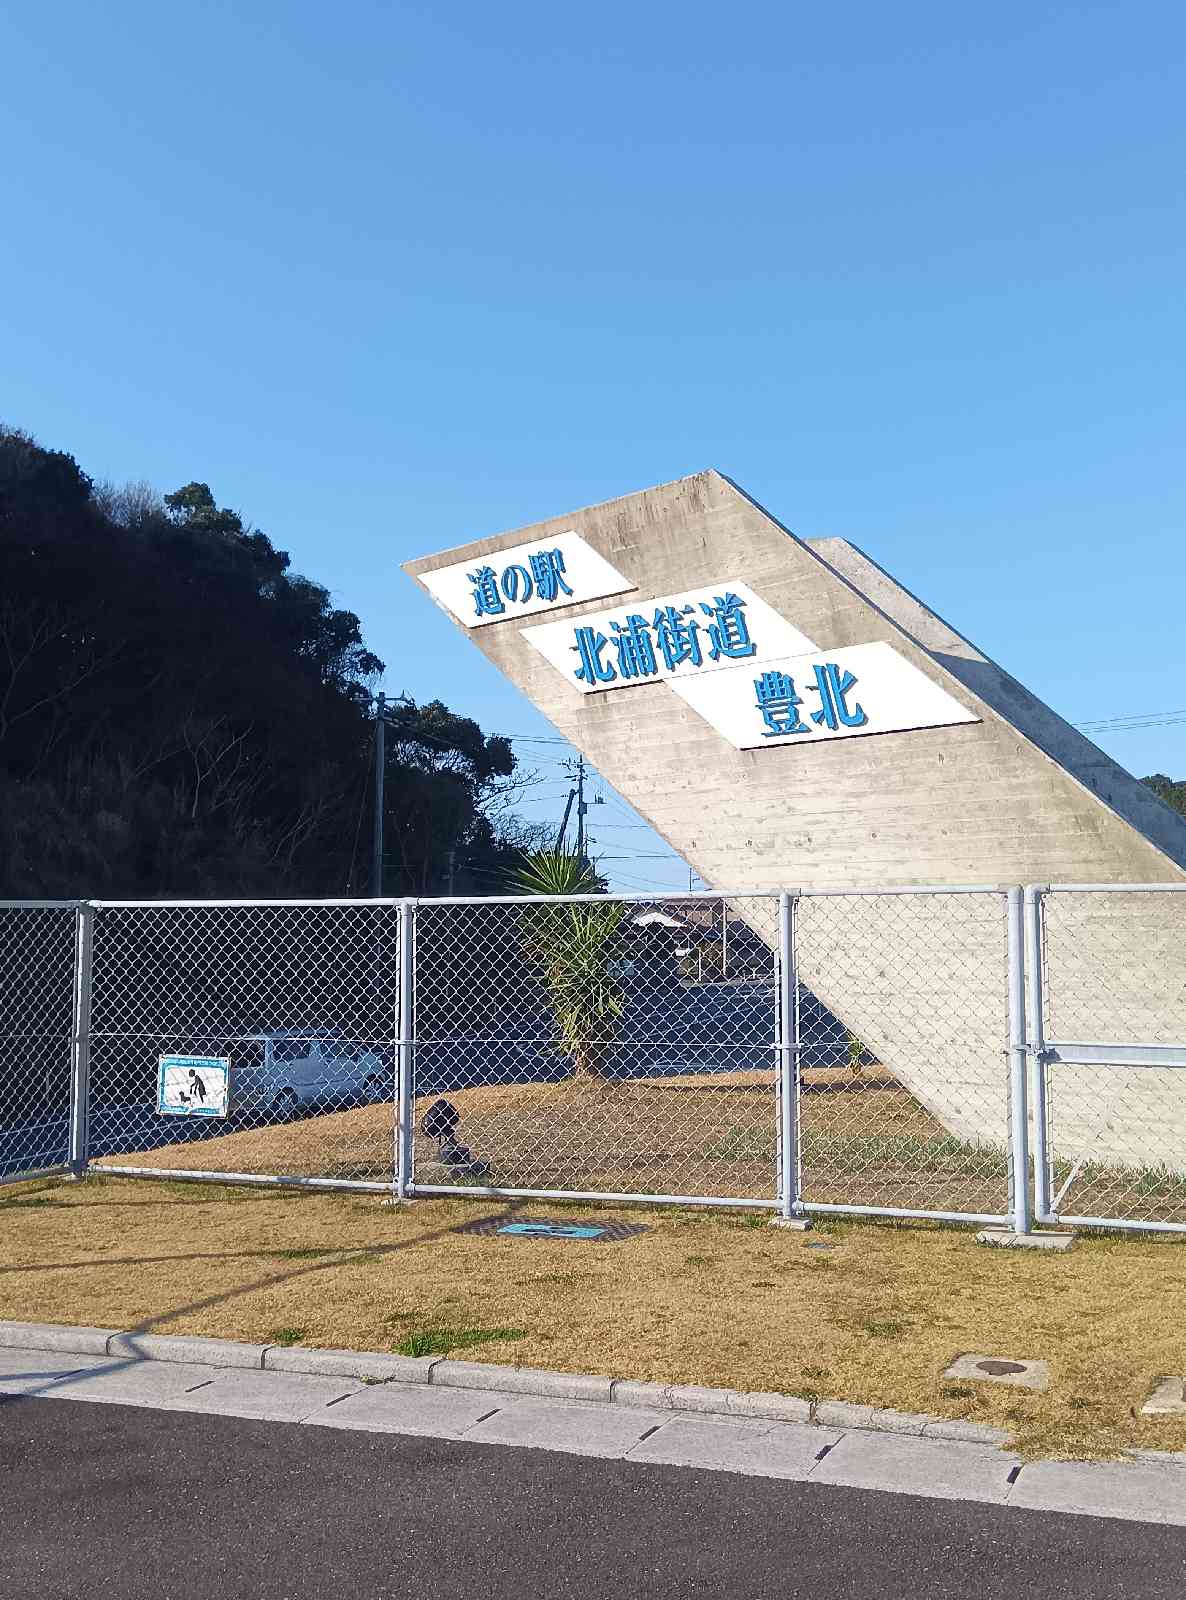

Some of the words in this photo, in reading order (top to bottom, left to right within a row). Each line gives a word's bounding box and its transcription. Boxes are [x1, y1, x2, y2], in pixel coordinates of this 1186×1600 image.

[466, 549, 573, 617] 道の駅
[571, 592, 757, 685] 北浦街道
[753, 663, 868, 737] 豊北
